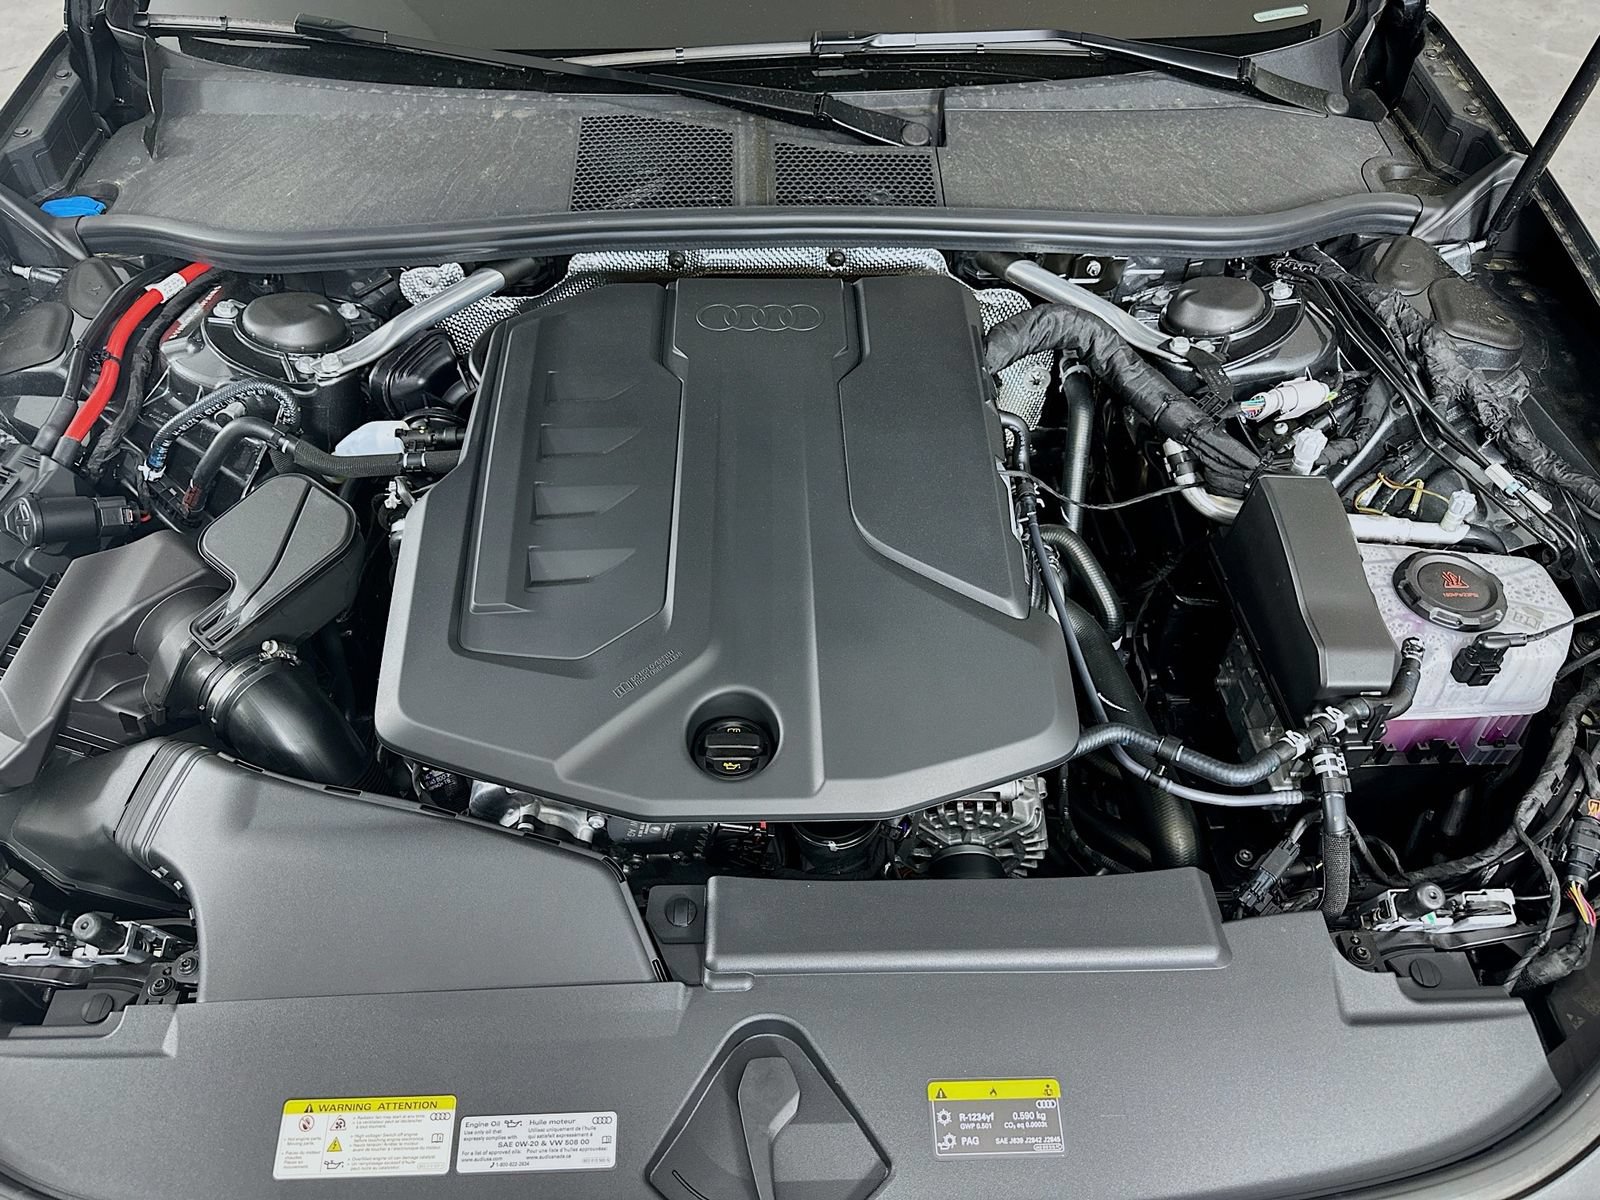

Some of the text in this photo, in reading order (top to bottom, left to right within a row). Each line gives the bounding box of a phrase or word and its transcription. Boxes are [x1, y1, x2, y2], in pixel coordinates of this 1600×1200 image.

[318, 1101, 438, 1112] WARNING ATTENTION
[959, 1111, 1046, 1122] R-1234yf 0.590 kg
[961, 1136, 980, 1146] PAG
